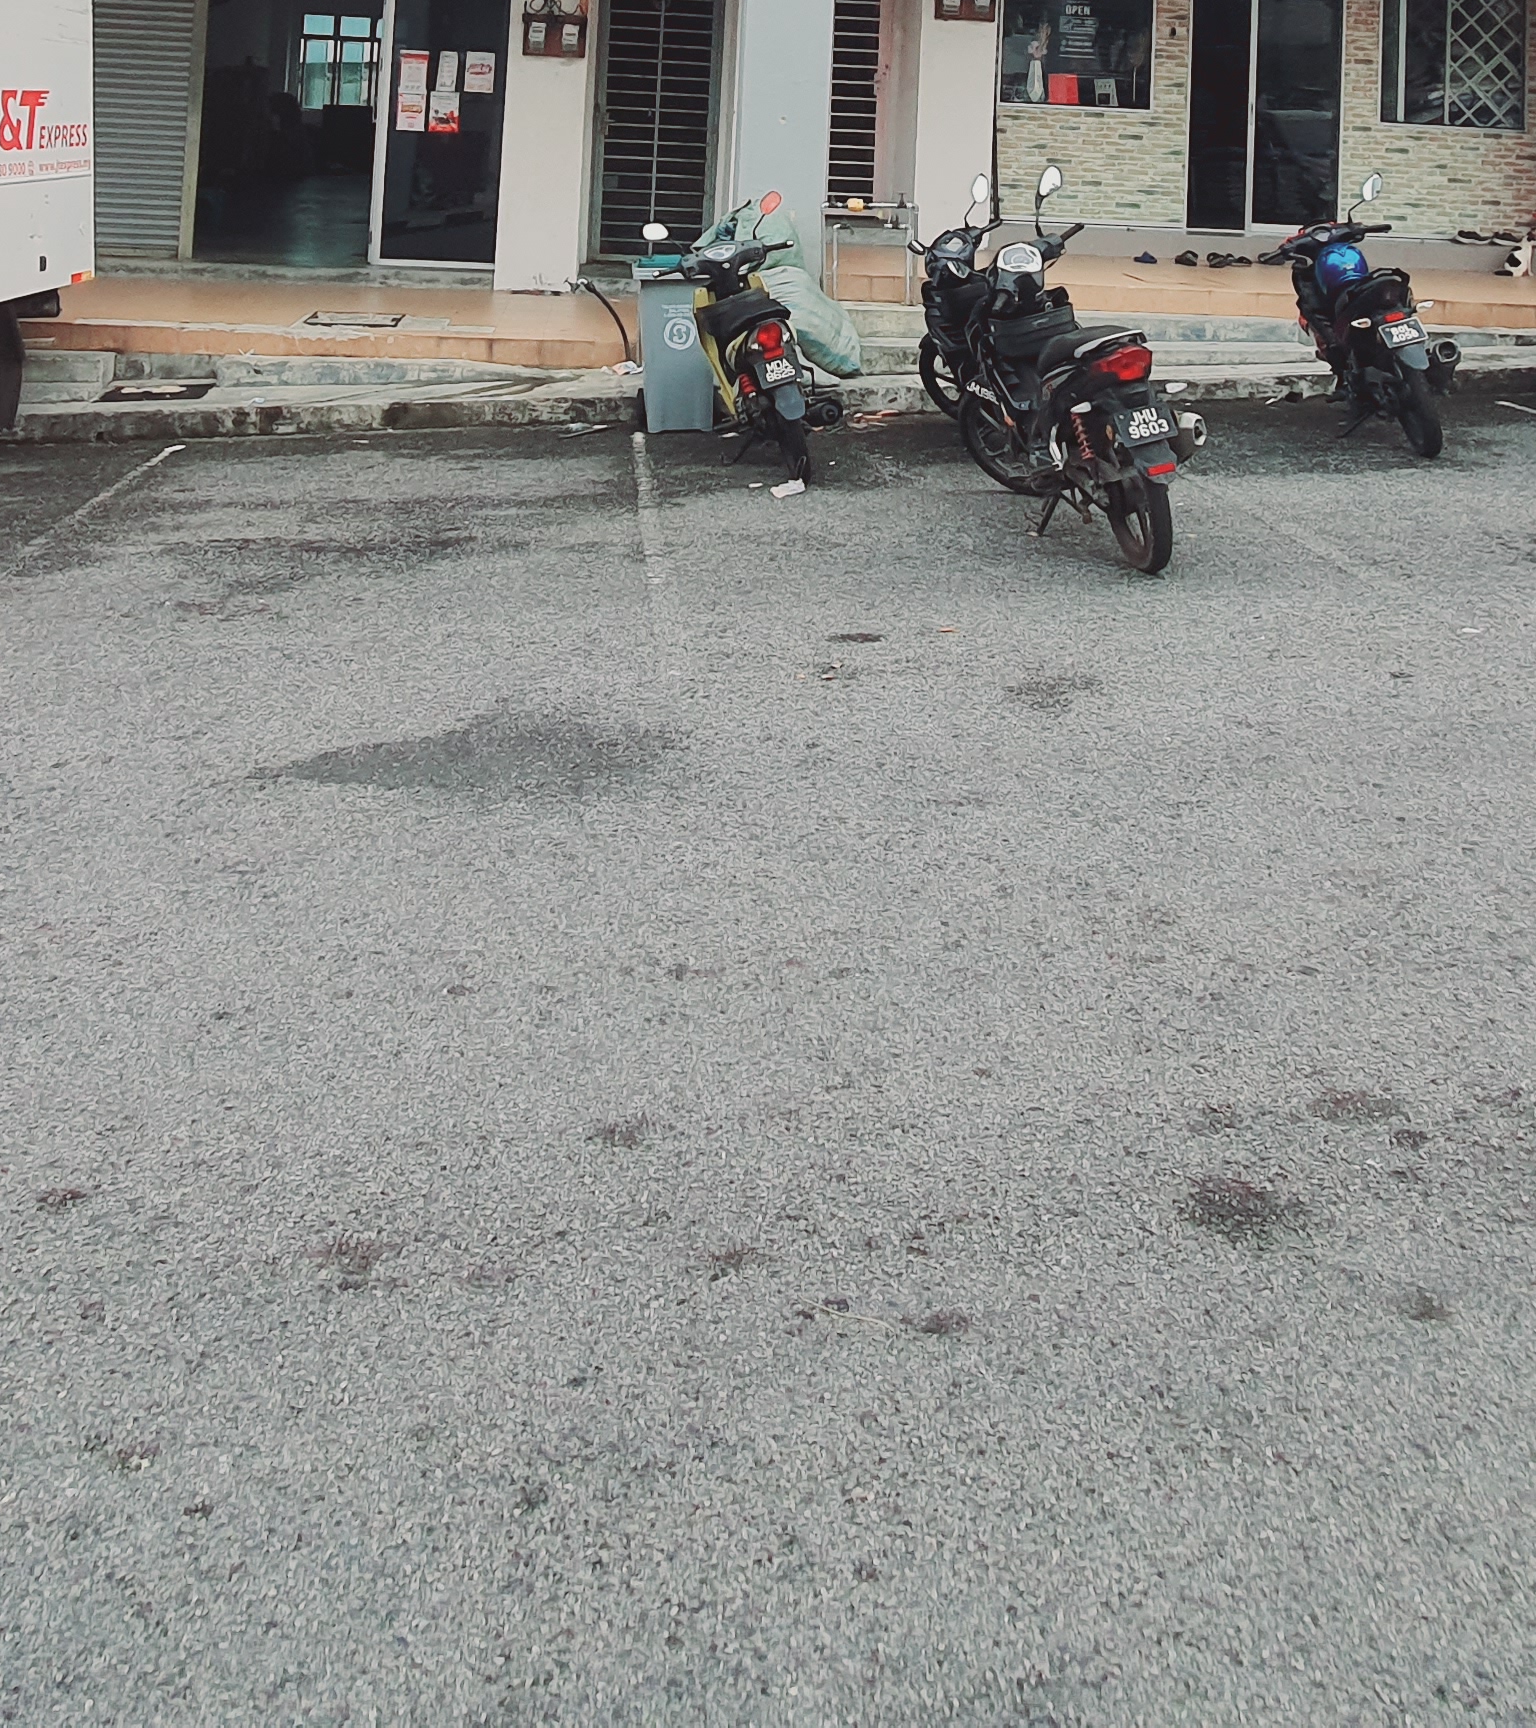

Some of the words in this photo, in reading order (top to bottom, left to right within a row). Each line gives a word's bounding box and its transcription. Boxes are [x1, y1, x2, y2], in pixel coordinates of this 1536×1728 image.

[1065, 4, 1091, 16] OPEN
[39, 124, 88, 150] EXPRESS
[765, 357, 794, 374] MDA
[1129, 407, 1158, 427] JHU
[1128, 418, 1170, 440] 9603
